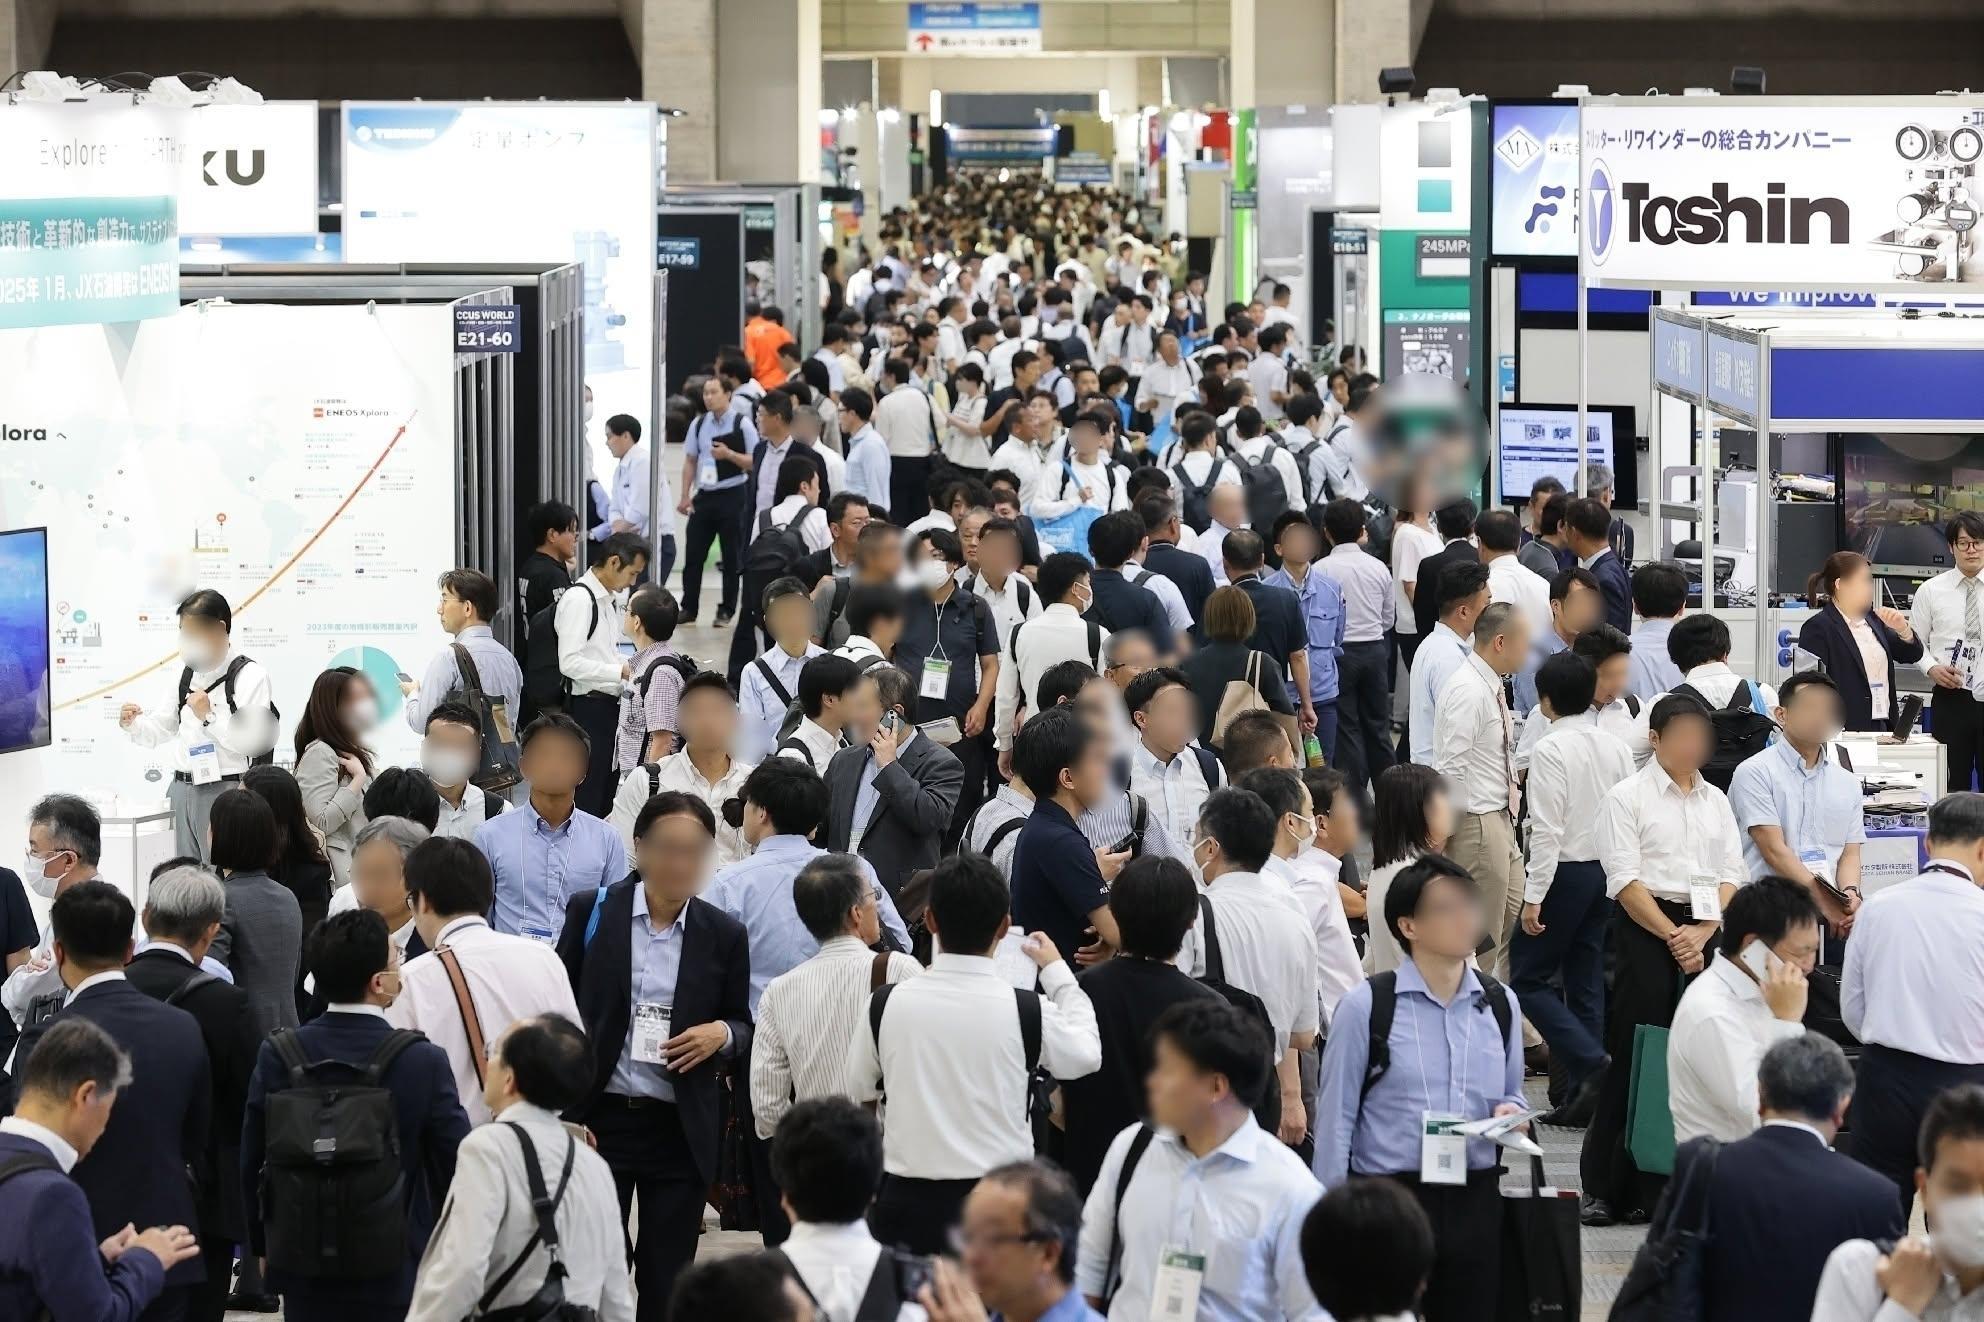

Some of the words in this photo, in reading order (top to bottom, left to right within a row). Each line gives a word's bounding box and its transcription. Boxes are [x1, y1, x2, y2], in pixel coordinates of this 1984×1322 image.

[1622, 182, 1850, 246] Toshin
[456, 310, 481, 320] CCUS
[482, 310, 515, 320] WORLD
[457, 331, 513, 347] E21-60
[326, 409, 358, 417] ENEOS
[1, 424, 47, 441] lora
